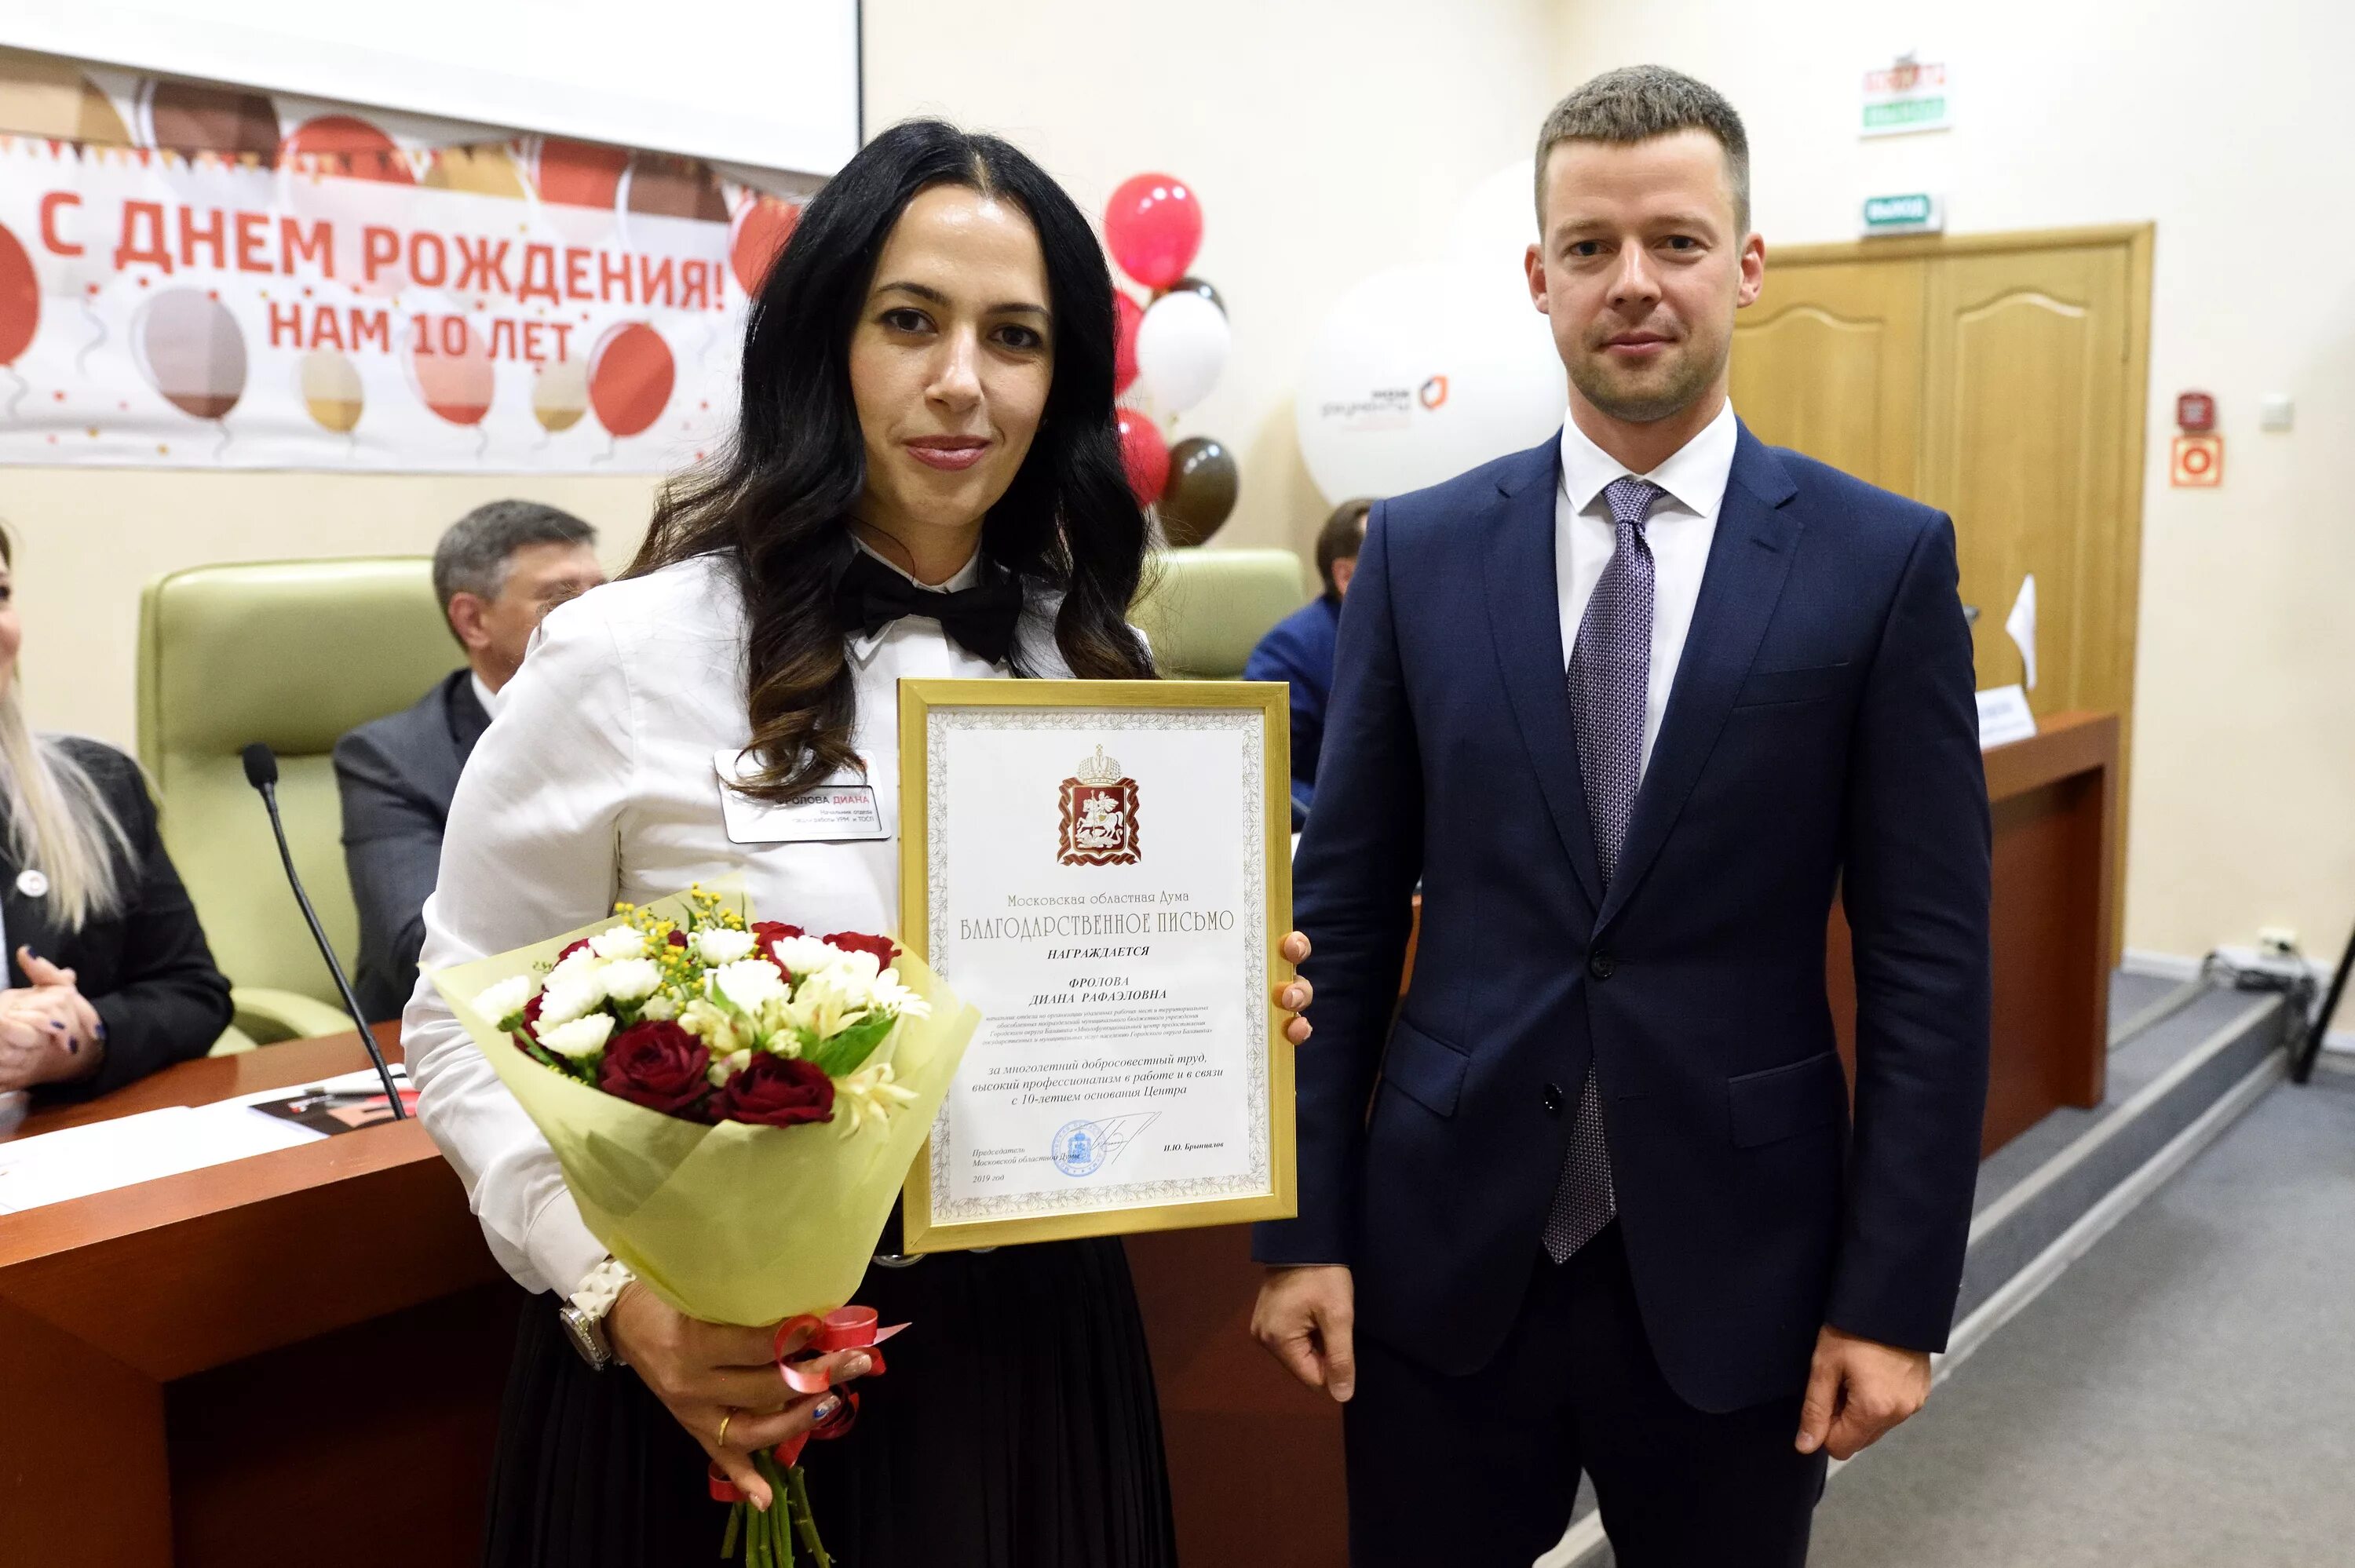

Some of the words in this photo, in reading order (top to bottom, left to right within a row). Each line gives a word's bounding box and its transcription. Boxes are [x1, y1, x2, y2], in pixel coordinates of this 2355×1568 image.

[38, 191, 84, 257] С
[113, 198, 336, 280] ДНЕМ
[363, 223, 727, 312] РОЖДЕНИЯ!
[268, 301, 392, 355] НАМ
[412, 312, 469, 359] 10
[487, 317, 575, 365] ЛЕТ
[833, 796, 870, 805] ДИАНА
[1008, 894, 1085, 907] Московская
[1090, 892, 1156, 905] областная
[1159, 890, 1189, 906] Дума
[960, 913, 1150, 943] БЛАГОДАРСТВЕННОЕ
[1158, 910, 1234, 932] ПИСЬМО
[1047, 946, 1150, 960] НАГРАЖДАЕТСЯ
[1068, 976, 1130, 988] ФРОЛОВА
[1028, 994, 1075, 1008] ДИАНА
[1082, 989, 1167, 1003] РАФАЭЛОВНА
[988, 1067, 1001, 1075] за
[1003, 1059, 1079, 1074] многолетний
[1082, 1054, 1174, 1070] добросовестный
[1178, 1053, 1207, 1066] труд,
[972, 1078, 1020, 1092] высокий
[1022, 1074, 1121, 1092] профессионализм
[1133, 1070, 1174, 1085] работе
[1195, 1068, 1224, 1078] связи
[1022, 1093, 1081, 1105] 10-летием
[1084, 1088, 1141, 1100] основания
[1144, 1086, 1188, 1098] Центра
[973, 1147, 1025, 1159] Председатель
[1185, 1142, 1224, 1151] Брынцалов
[973, 1156, 1017, 1168] Московской
[1018, 1154, 1058, 1163] областной
[973, 1174, 991, 1183] 2019
